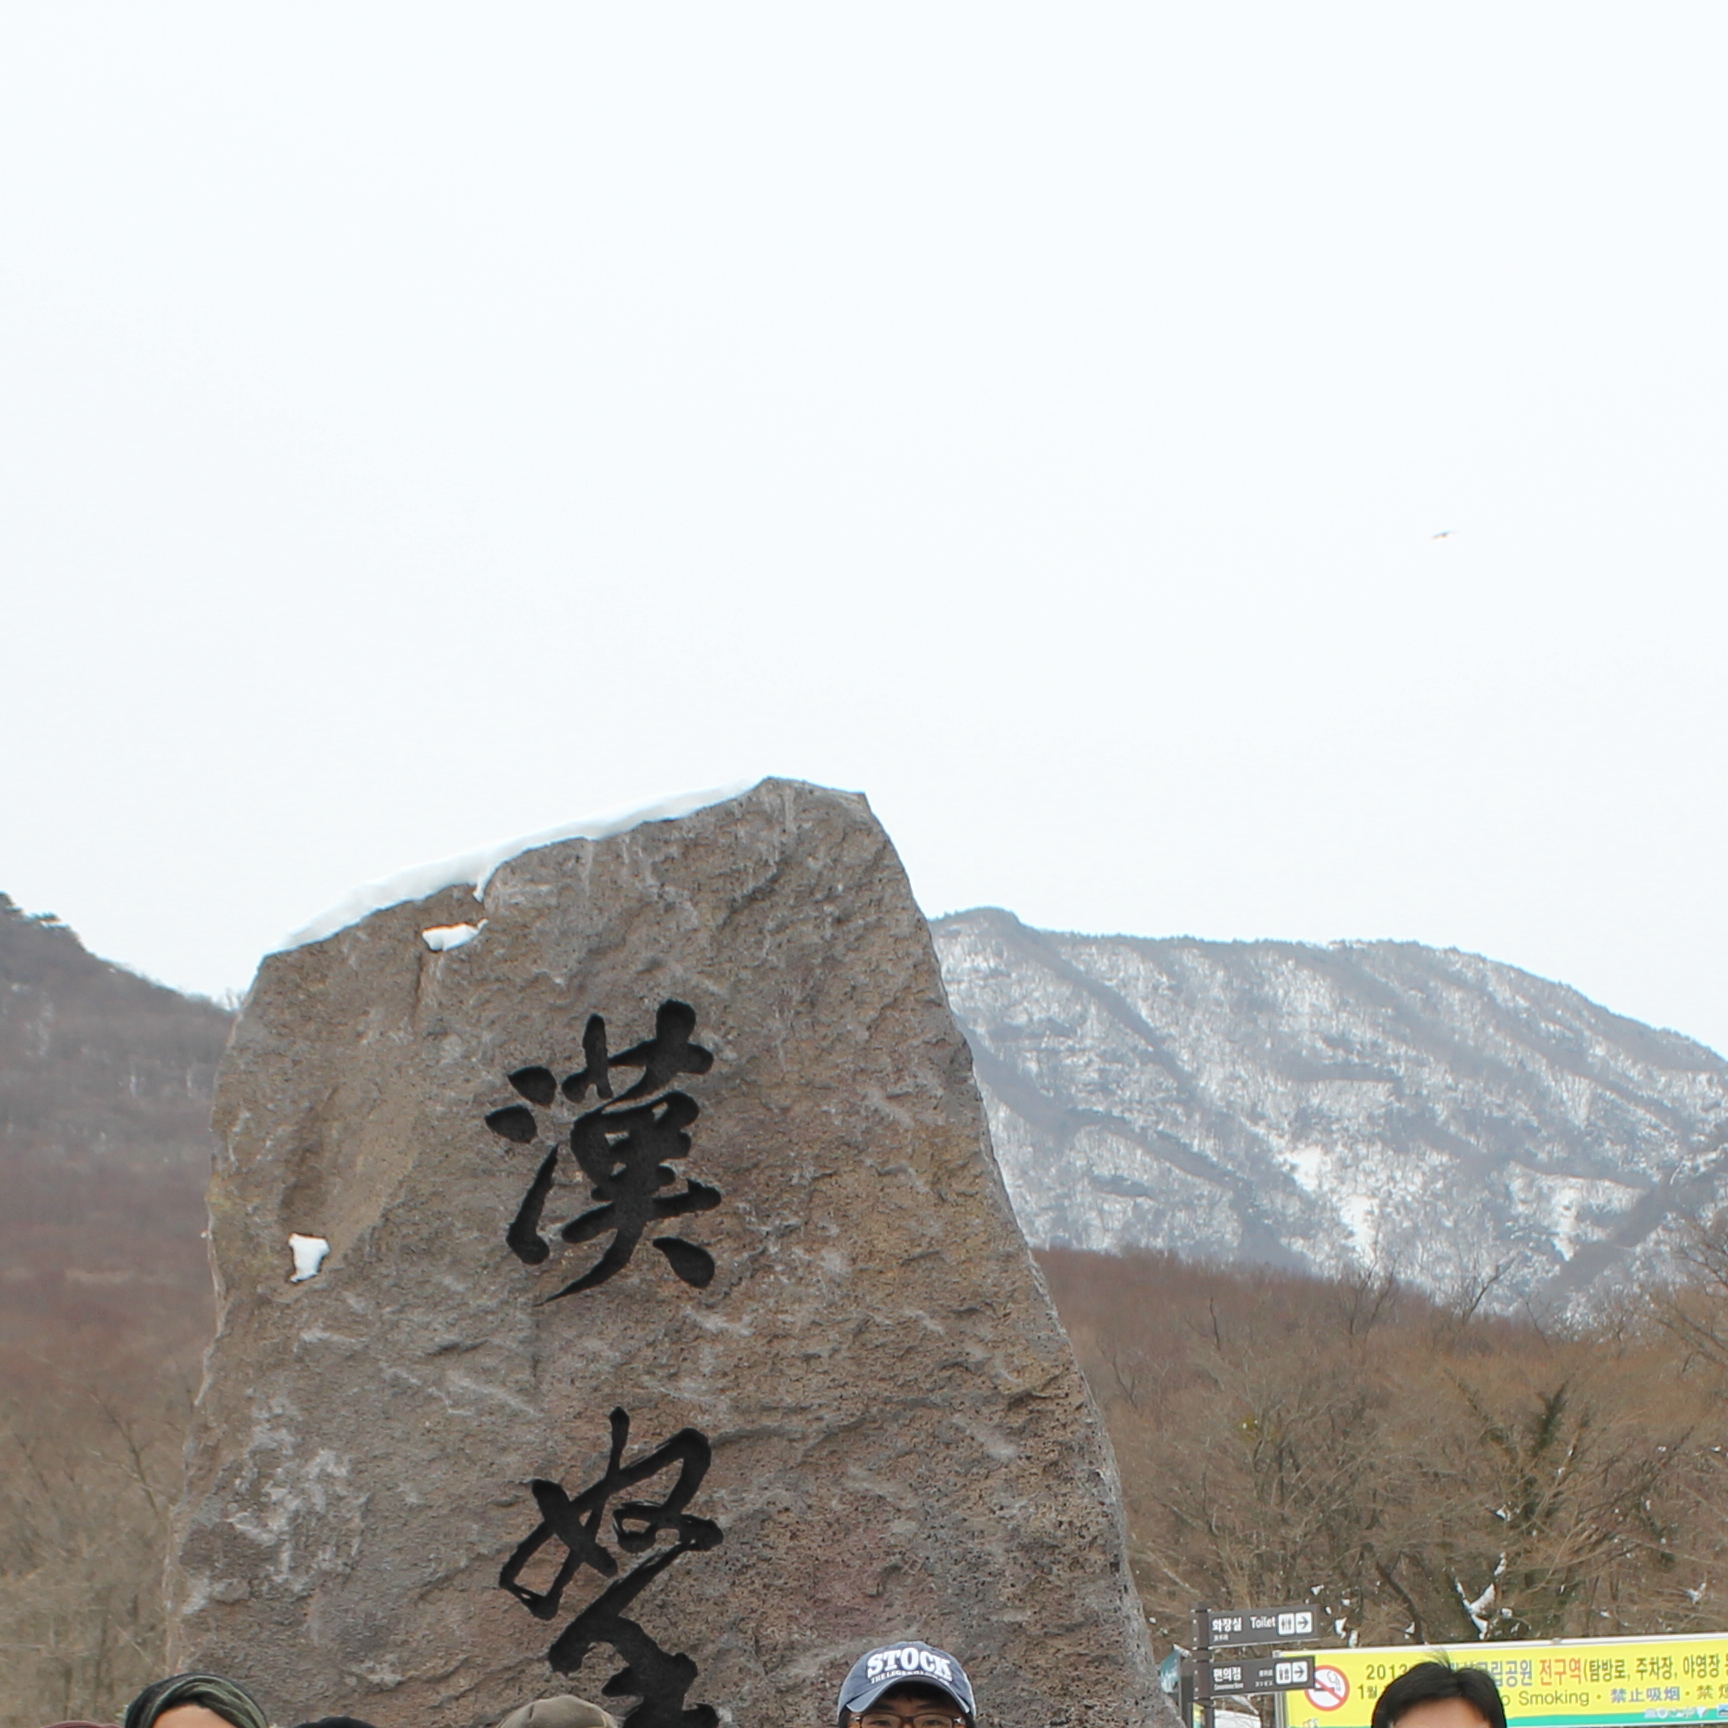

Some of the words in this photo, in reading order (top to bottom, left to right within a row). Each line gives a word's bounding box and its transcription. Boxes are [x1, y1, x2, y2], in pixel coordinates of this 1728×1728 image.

[1212, 1616, 1242, 1632] 화장실
[1250, 1616, 1276, 1629] Toilet
[867, 1647, 953, 1682] STOCK
[1635, 1654, 1678, 1681] 주차장,
[1683, 1653, 1720, 1679] 야영장
[1213, 1667, 1241, 1682] 편의점
[1519, 1690, 1590, 1707] Smoking
